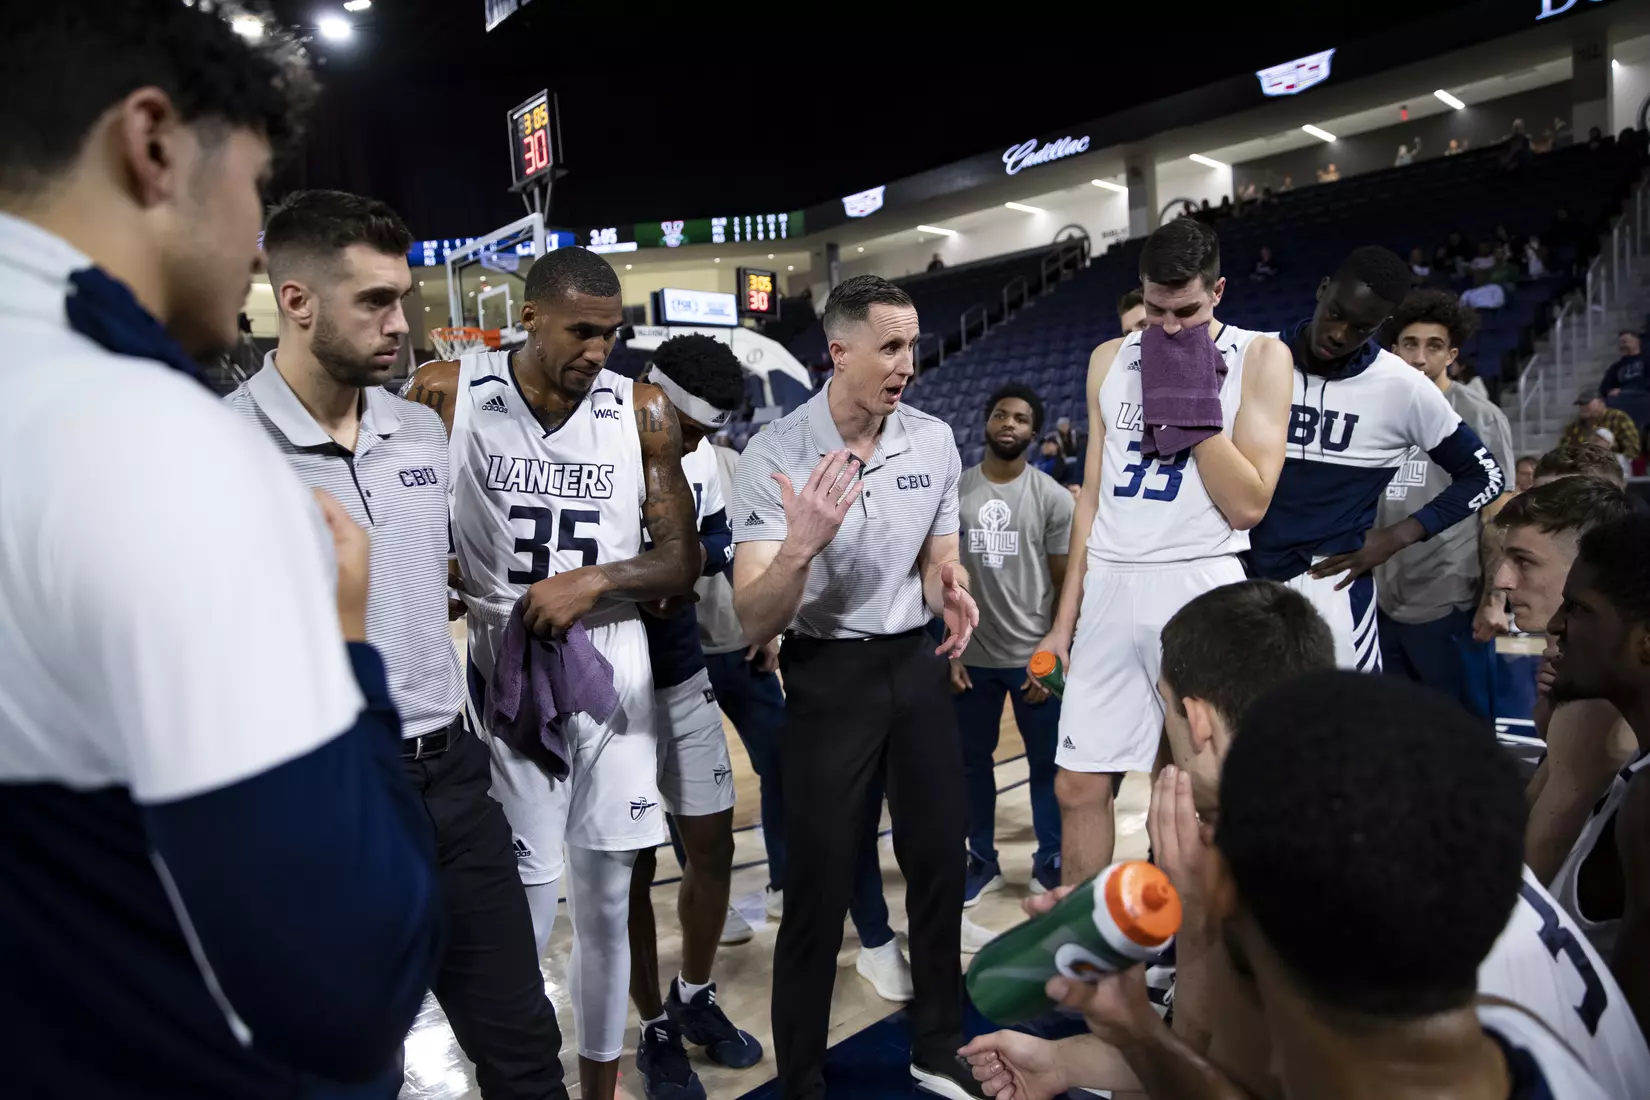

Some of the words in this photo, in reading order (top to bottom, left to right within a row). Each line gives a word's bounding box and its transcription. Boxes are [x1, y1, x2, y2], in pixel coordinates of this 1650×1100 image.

[523, 128, 549, 175] 30
[1002, 135, 1091, 175] Cadillac
[749, 290, 769, 311] 30
[481, 404, 509, 414] adidas
[593, 409, 620, 421] WAC
[1286, 403, 1360, 453] BU
[399, 467, 438, 488] CBU
[486, 455, 615, 500] LANCERS
[896, 474, 931, 490] CBU
[1113, 440, 1193, 503] 33
[507, 504, 601, 585] 35
